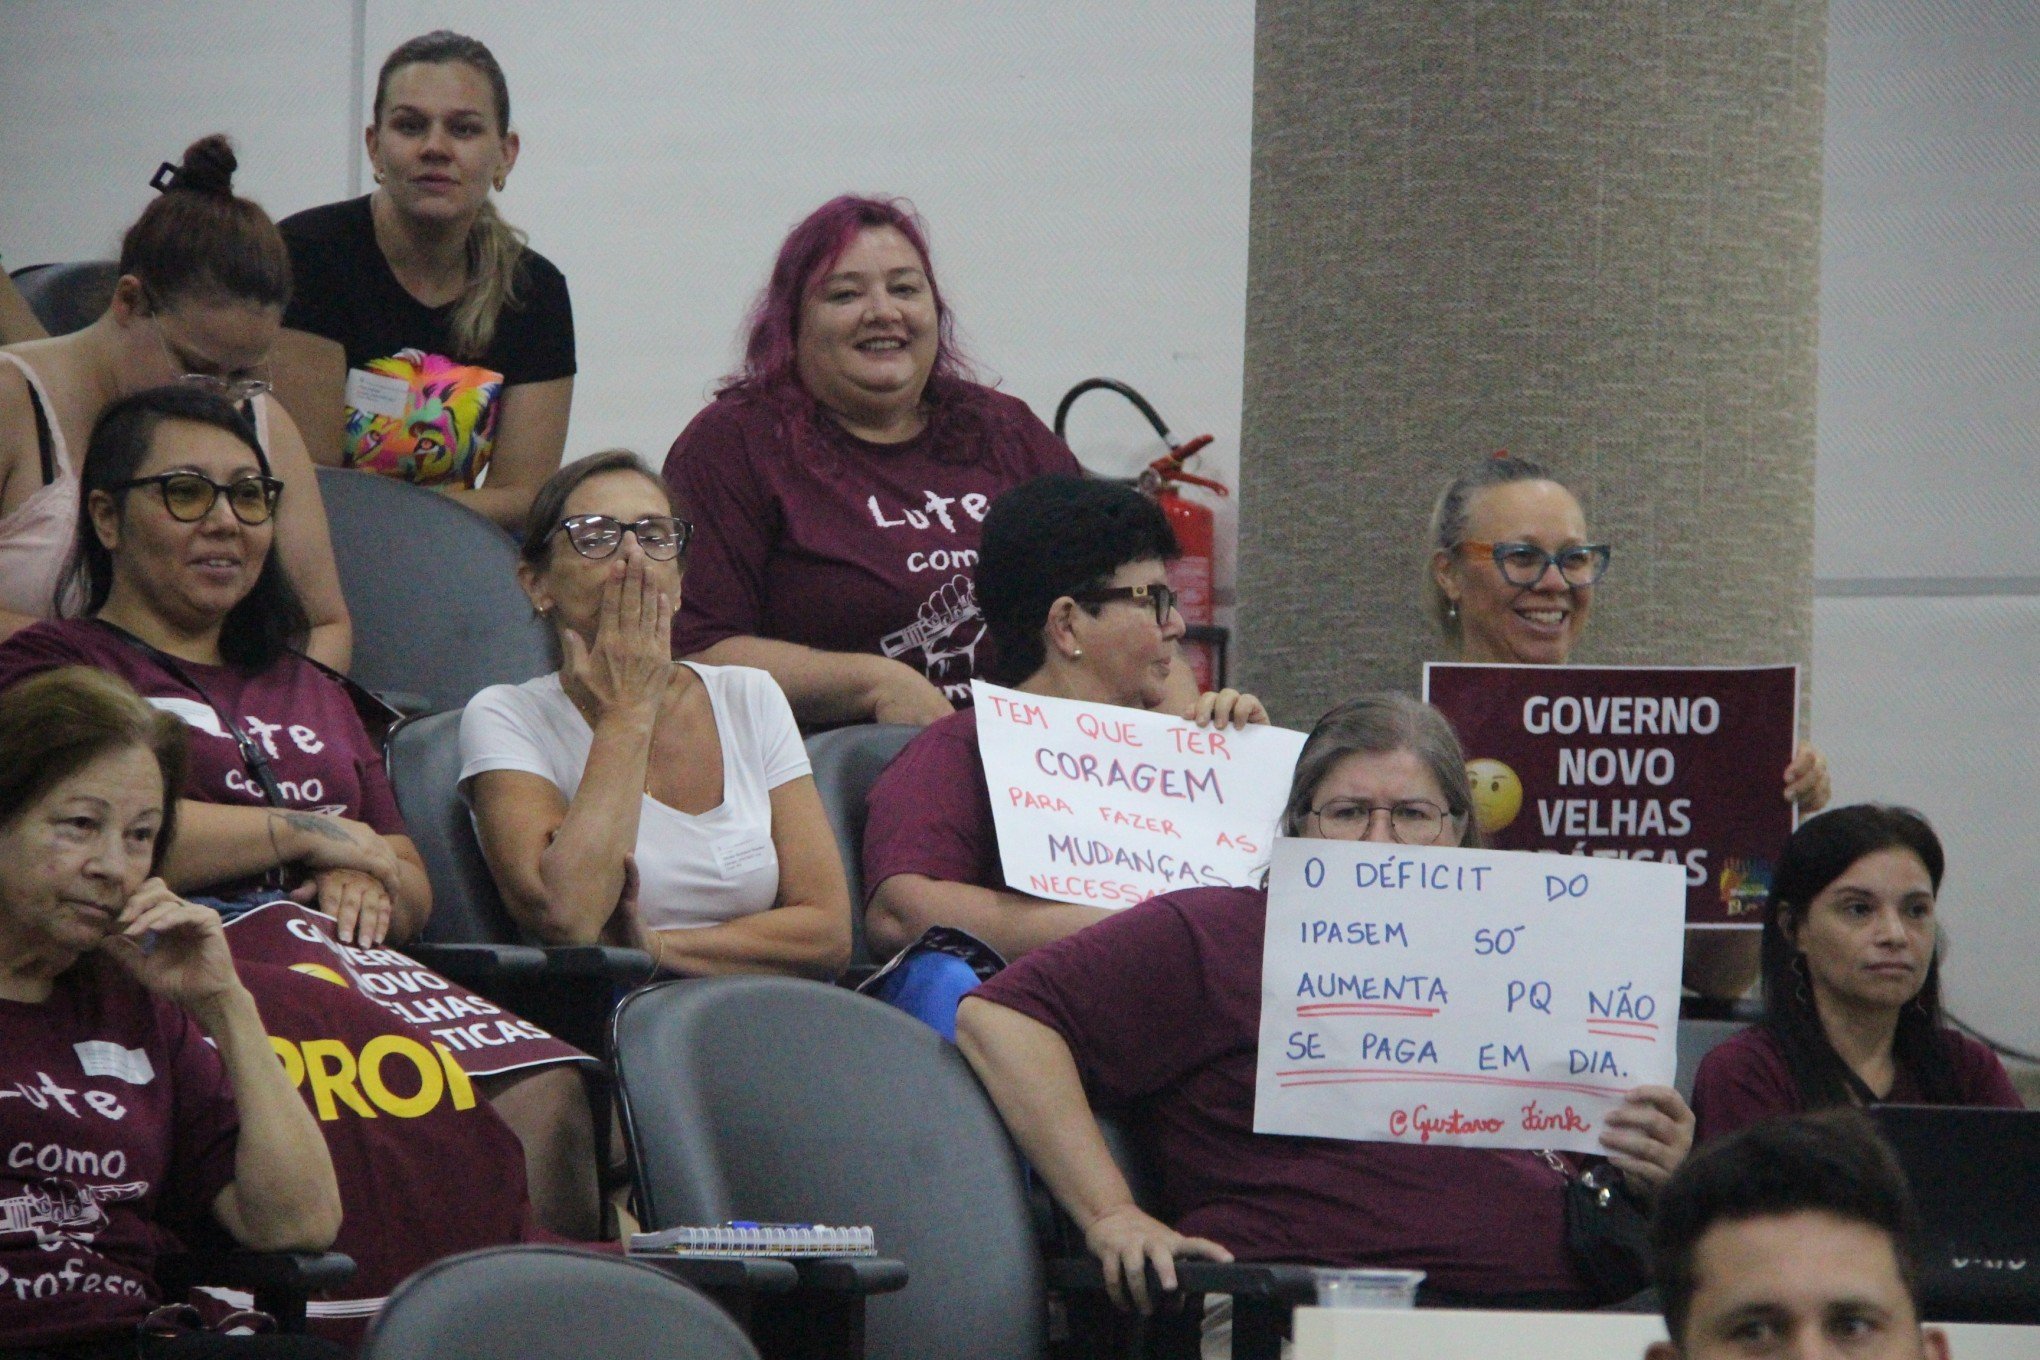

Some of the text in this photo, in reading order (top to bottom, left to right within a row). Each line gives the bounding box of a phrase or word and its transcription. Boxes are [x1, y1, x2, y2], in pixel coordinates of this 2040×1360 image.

[867, 490, 991, 533] Lute
[988, 695, 1231, 761] TEM QUE TER
[1523, 696, 1720, 735] GOVERNO
[1035, 748, 1224, 805] CORAGEM
[1558, 748, 1675, 786] NOVO
[1008, 786, 1258, 854] PARA FAZER AS
[1537, 799, 1692, 837] VELHAS
[1048, 834, 1233, 889] MUDANÇAS
[1304, 857, 1326, 889] O
[1355, 855, 1492, 892] DÉFICIT
[1545, 873, 1589, 902] DO
[1300, 920, 1527, 955] IPASEM SÓ
[1296, 972, 1656, 1021] AUMENTA PQ NÃO
[1286, 1031, 1628, 1078] SE PAGA EM DIA.
[0, 1070, 128, 1120] ute
[8, 1141, 127, 1179] como
